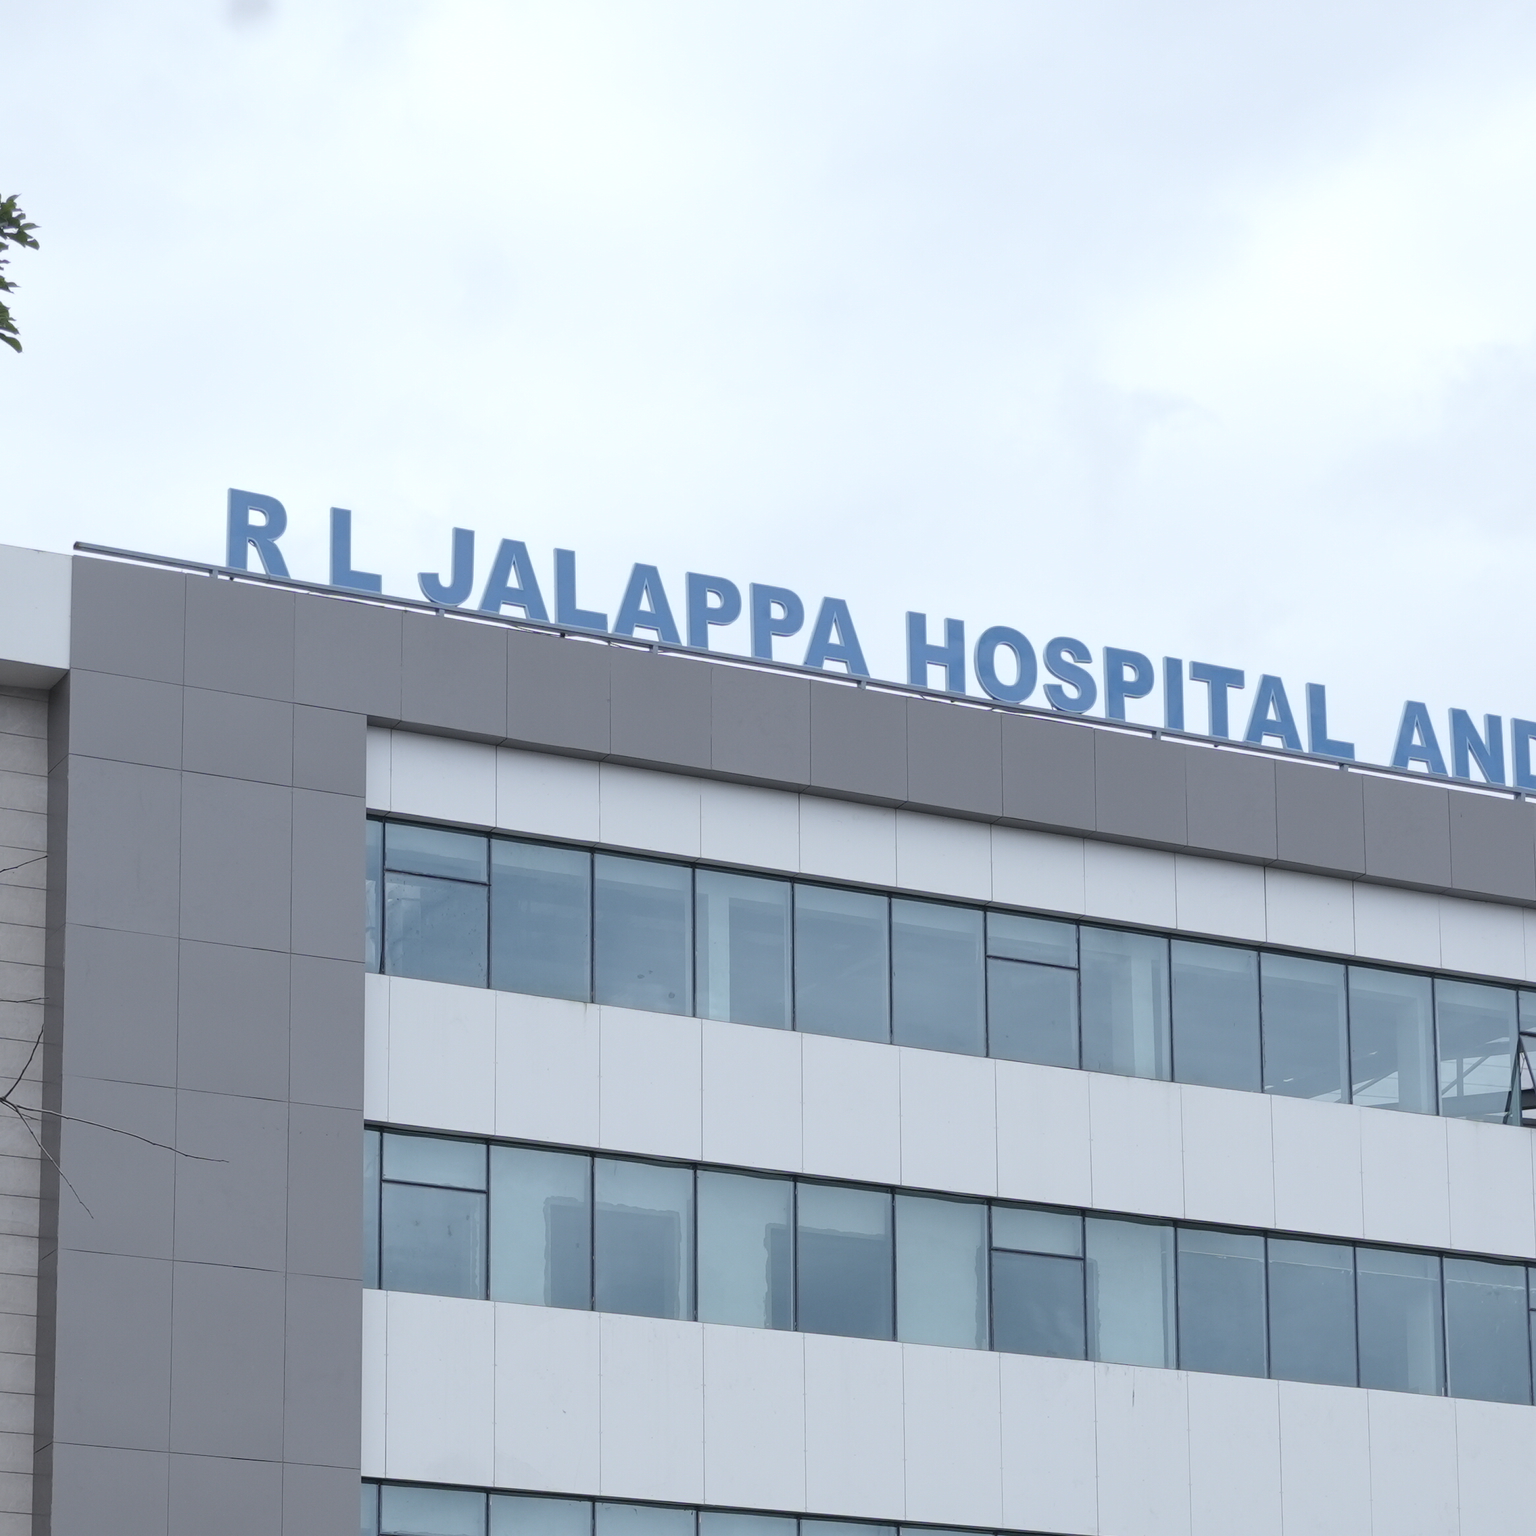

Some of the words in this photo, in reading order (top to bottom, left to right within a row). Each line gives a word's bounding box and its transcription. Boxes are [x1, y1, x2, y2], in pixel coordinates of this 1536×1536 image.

[227, 487, 291, 579] R
[330, 506, 382, 593] L
[417, 526, 871, 679] JALAPPA
[906, 610, 1355, 762] HOSPITAL
